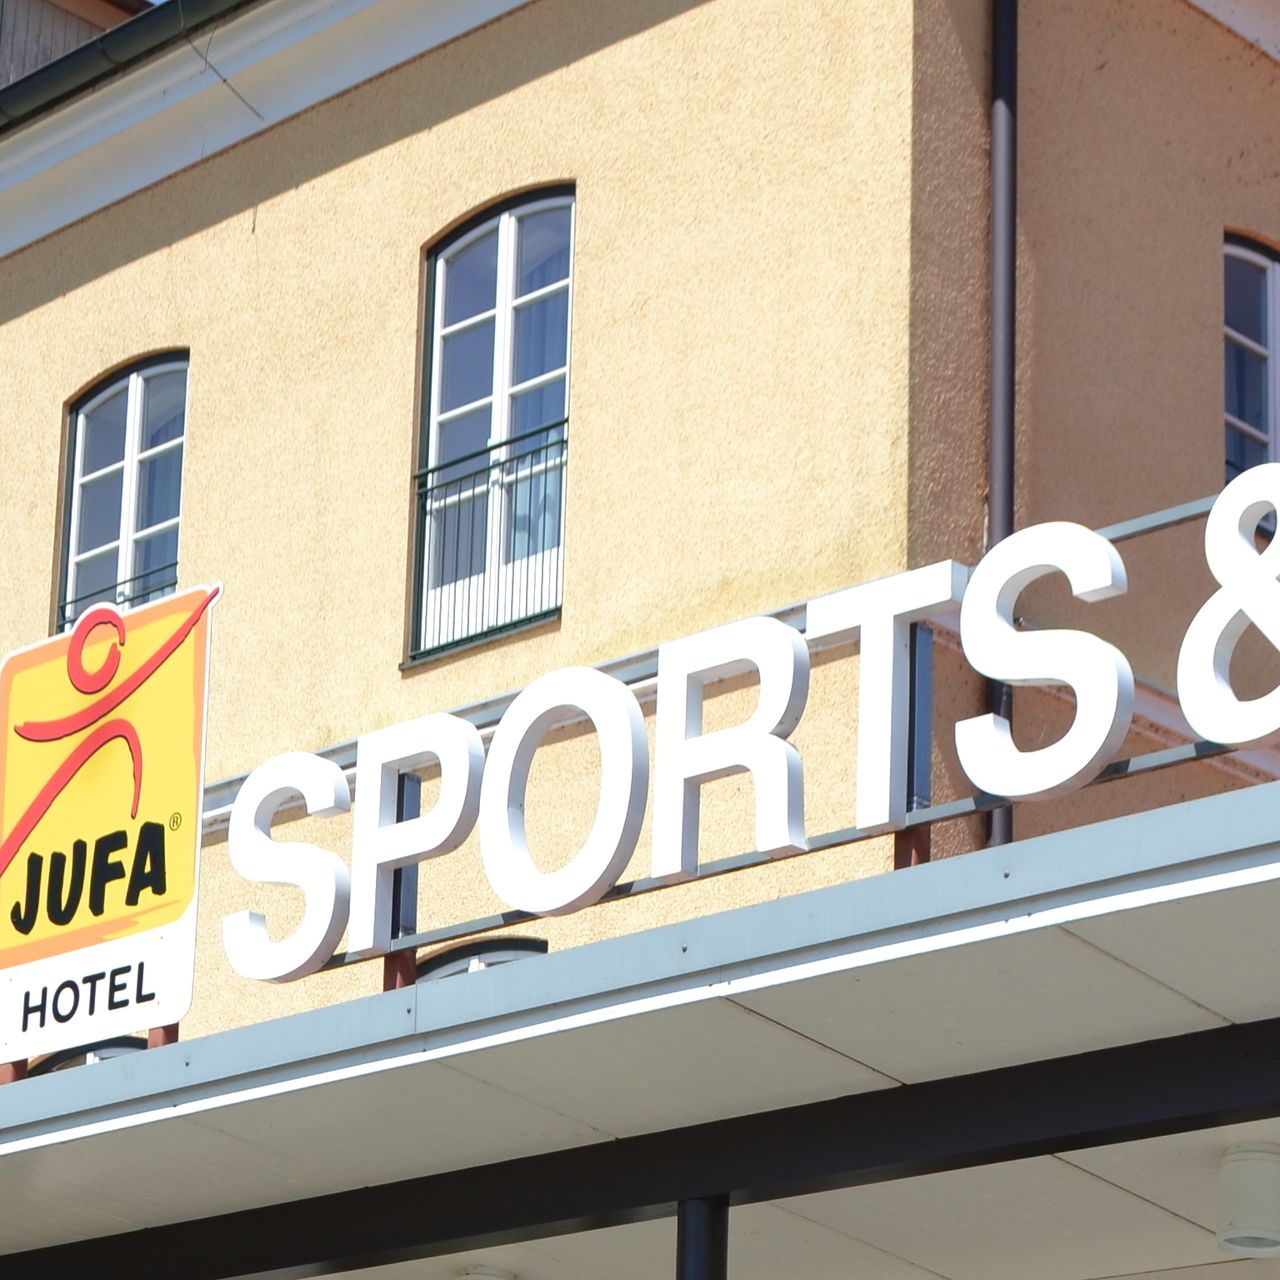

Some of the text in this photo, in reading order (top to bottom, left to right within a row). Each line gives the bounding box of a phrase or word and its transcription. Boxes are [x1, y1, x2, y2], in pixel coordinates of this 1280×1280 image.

[223, 521, 1135, 983] SPORTS
[10, 821, 166, 935] JUFA
[22, 961, 155, 1032] HOTEL
